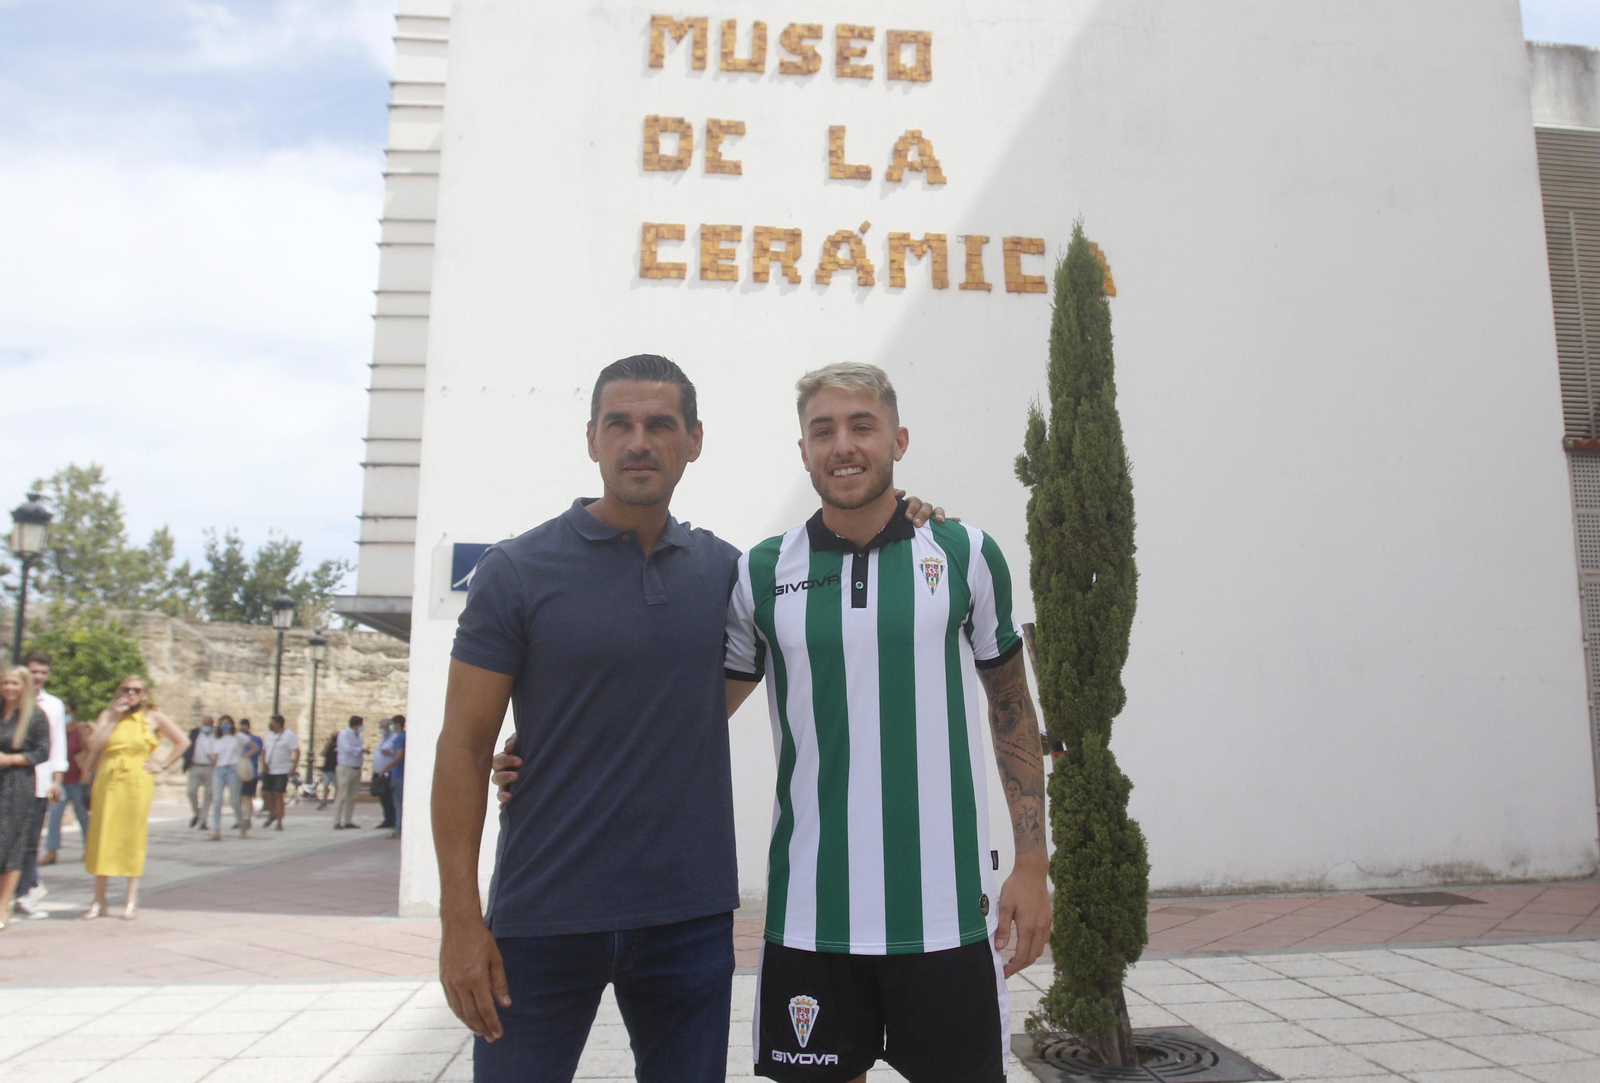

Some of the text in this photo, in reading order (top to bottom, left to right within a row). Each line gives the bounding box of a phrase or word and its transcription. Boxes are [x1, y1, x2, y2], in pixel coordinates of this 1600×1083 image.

[648, 14, 933, 82] MUSEO
[828, 125, 947, 185] LA
[772, 574, 841, 597] GIVOVA
[772, 1049, 838, 1066] GIVOVA
